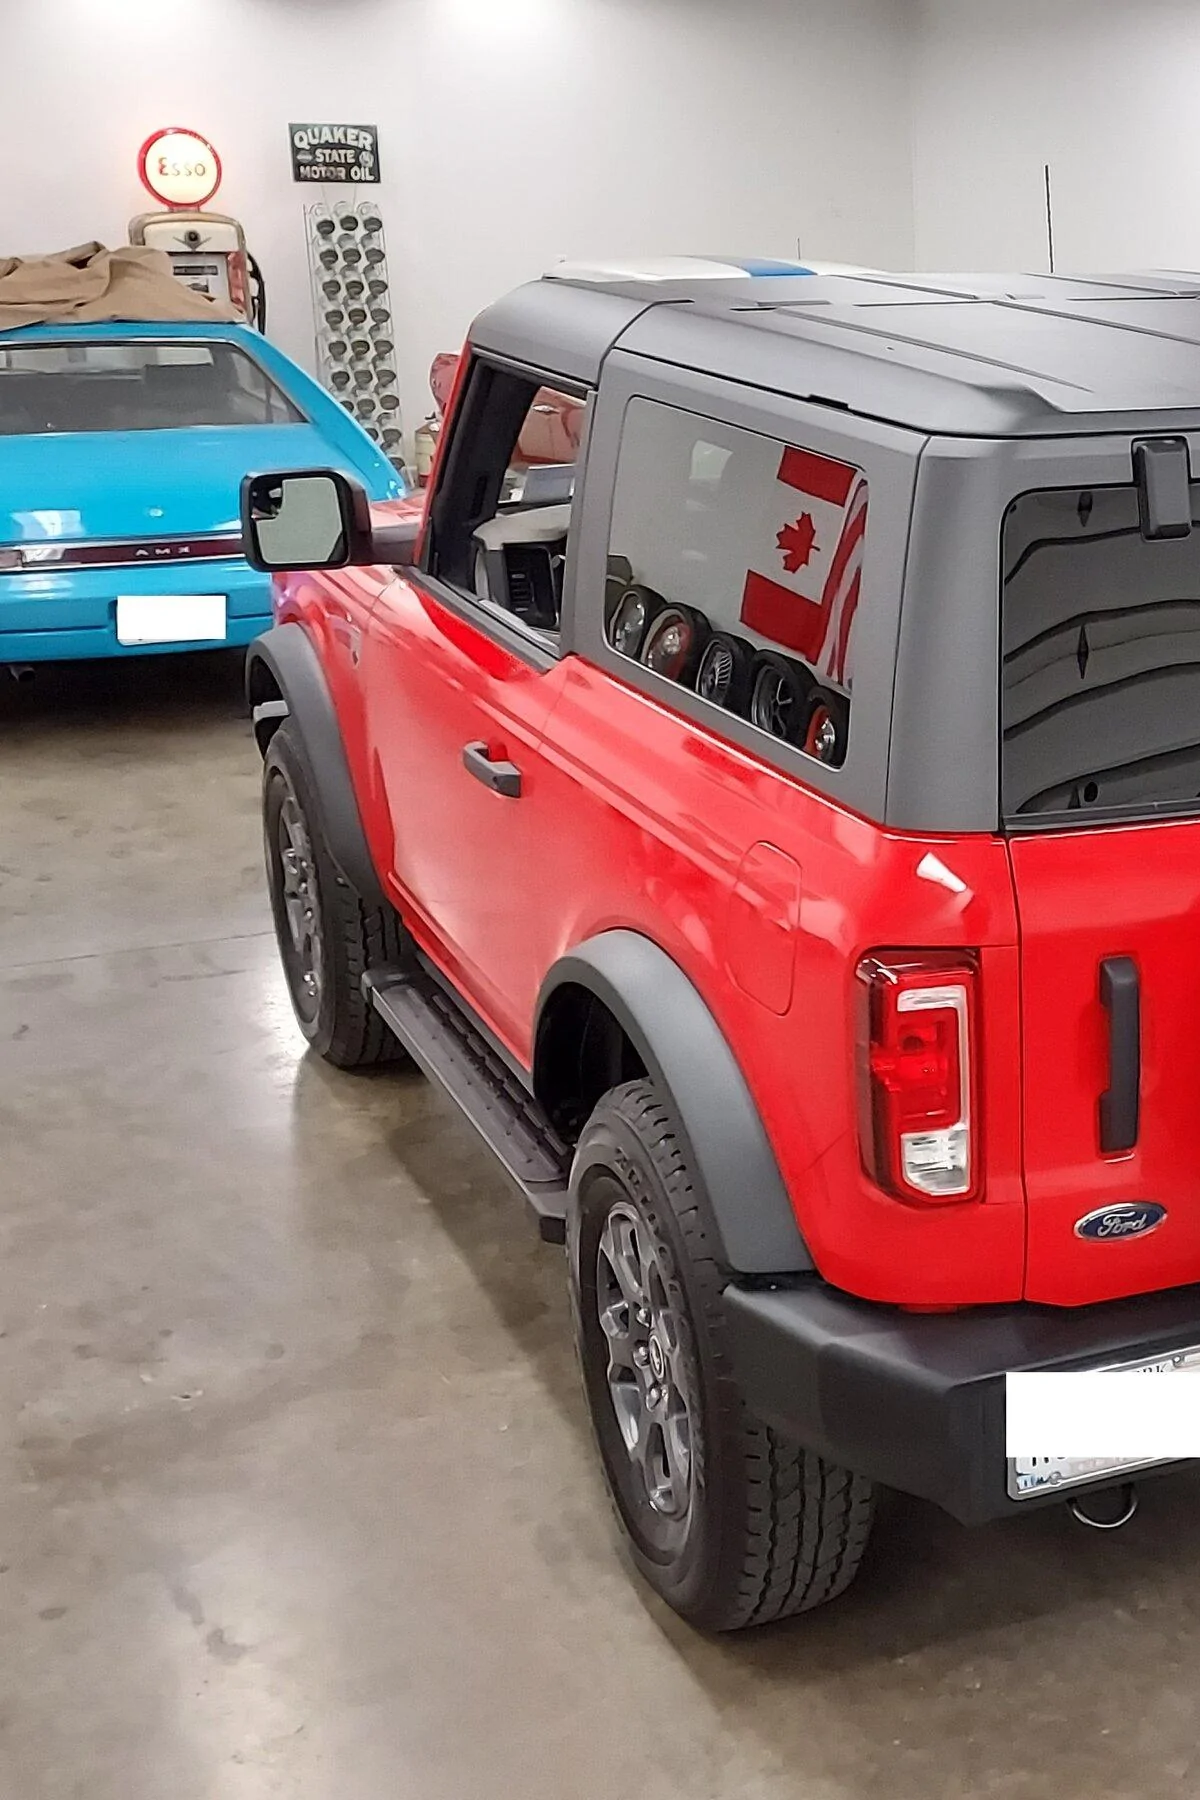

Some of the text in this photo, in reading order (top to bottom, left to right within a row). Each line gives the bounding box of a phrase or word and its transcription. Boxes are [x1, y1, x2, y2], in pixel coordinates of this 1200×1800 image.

[293, 126, 374, 151] QUAKER
[315, 148, 356, 163] STATE
[299, 165, 375, 181] MOTOR OIL
[135, 546, 191, 557] AMX
[1097, 1211, 1147, 1237] Ford
